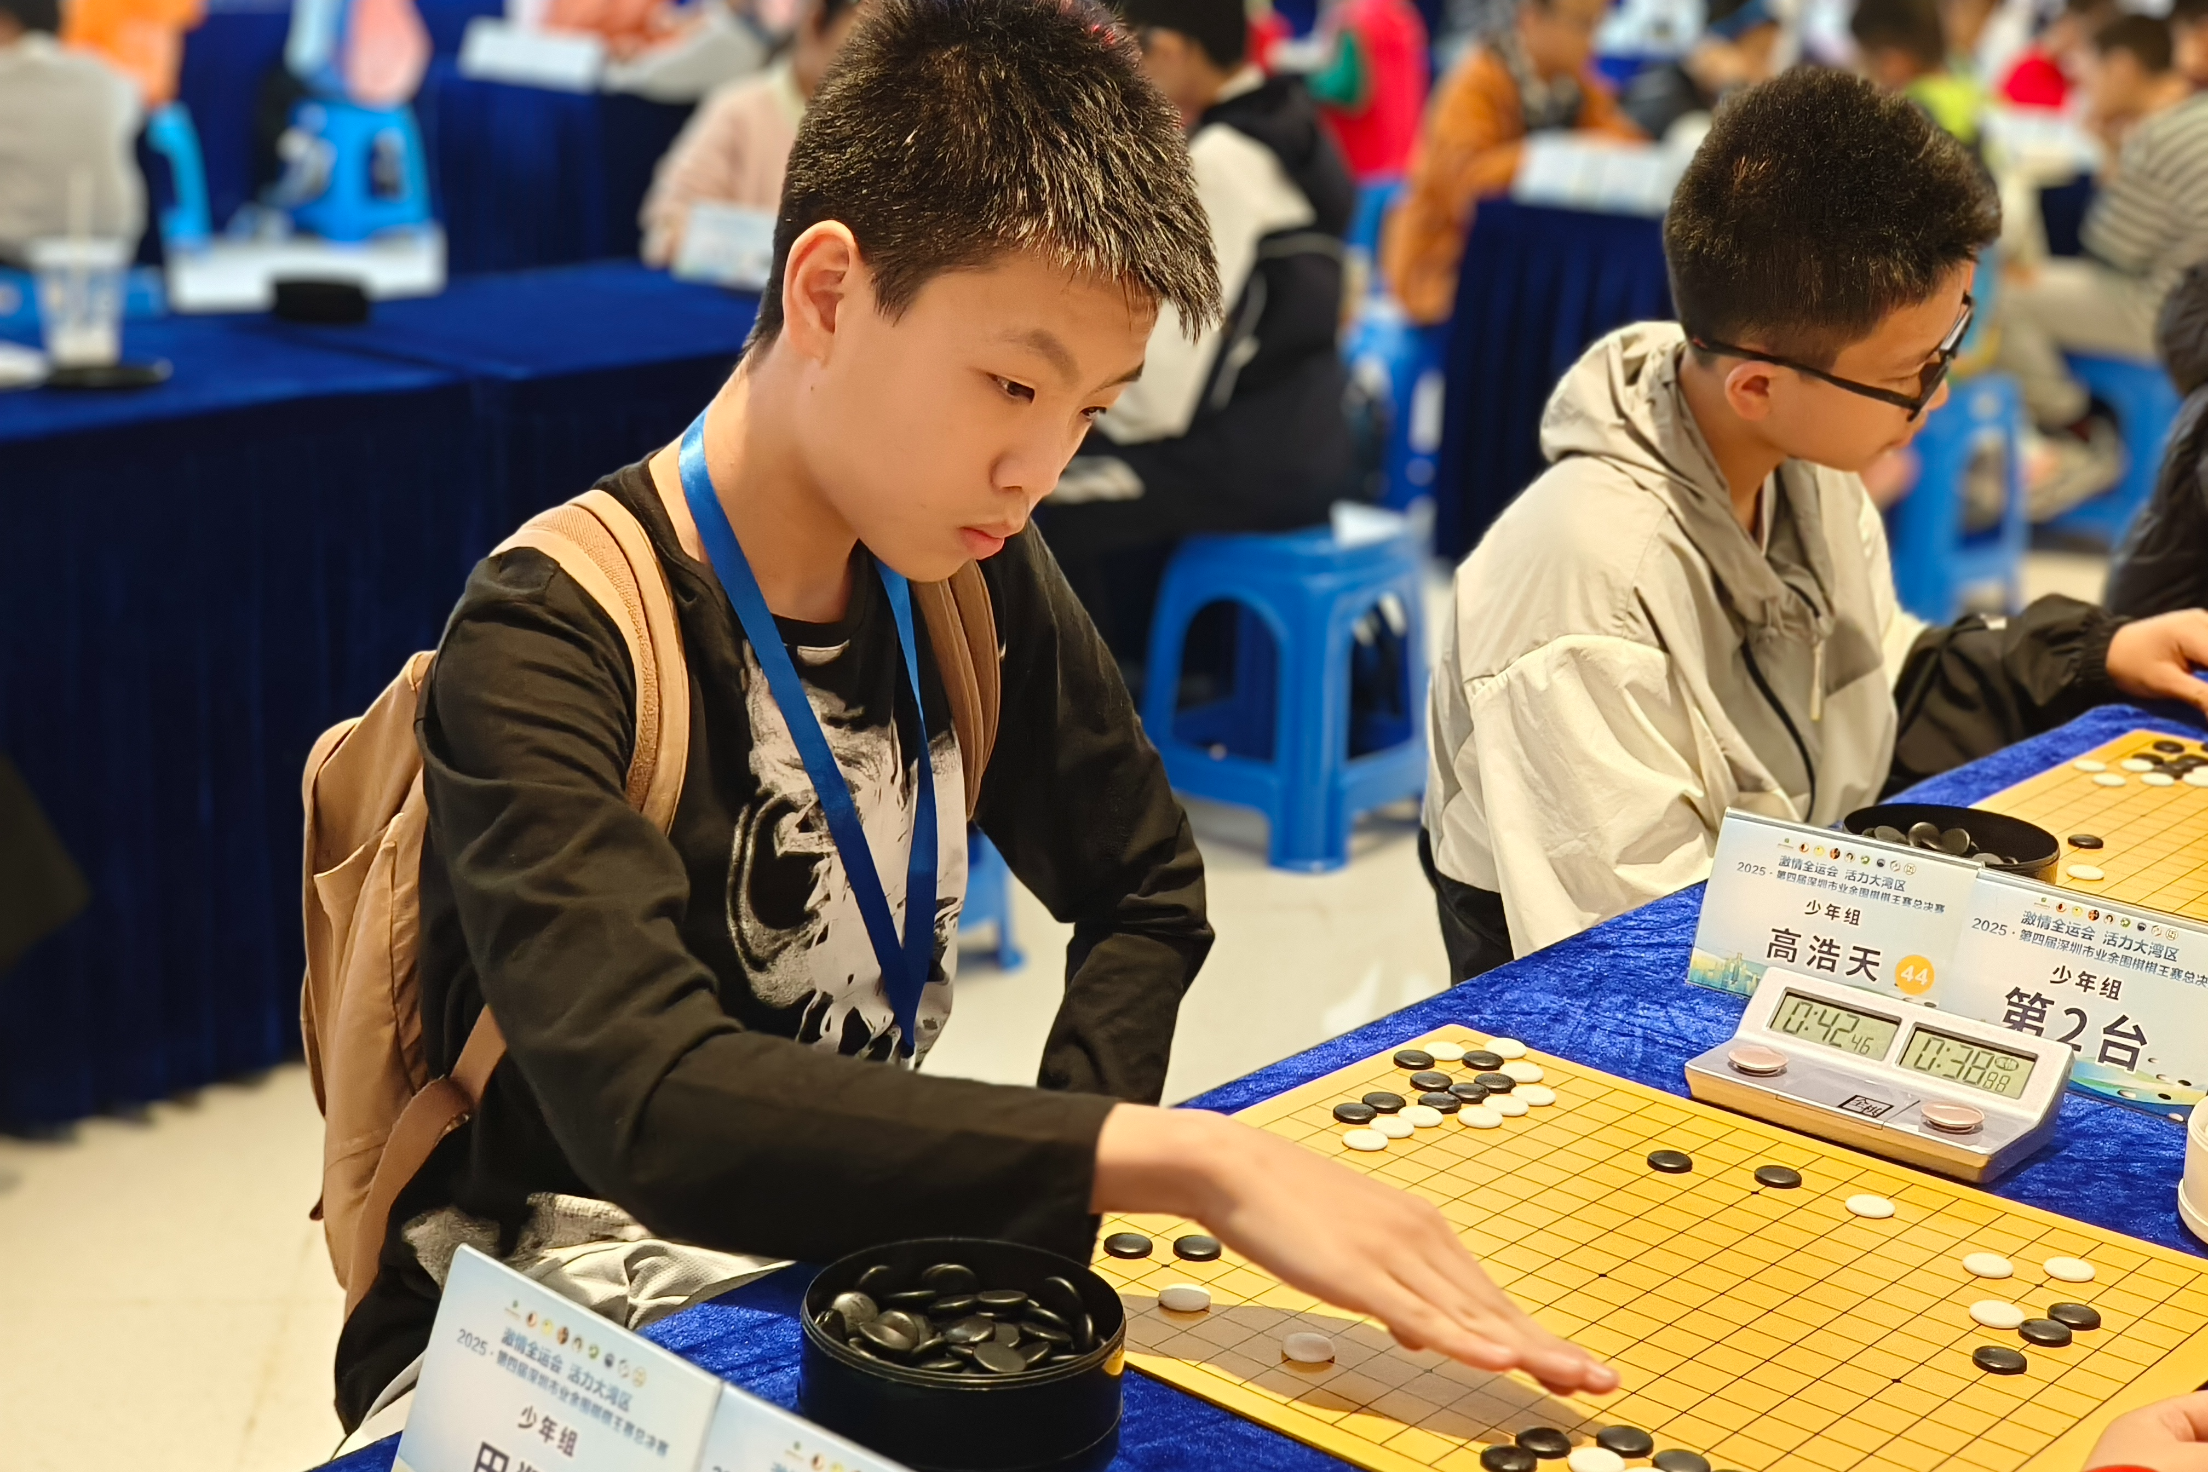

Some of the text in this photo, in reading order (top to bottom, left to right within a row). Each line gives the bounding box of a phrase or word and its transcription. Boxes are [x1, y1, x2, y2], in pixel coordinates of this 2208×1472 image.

[1778, 855, 1907, 892] 激情全运会 活力大湾区
[1804, 899, 1861, 926] 少年组
[1766, 928, 1881, 982] 高浩天
[2020, 910, 2180, 962] 激情全运会 活力大湾区
[1900, 964, 1928, 986] 44
[2050, 965, 2123, 1001] 少年组
[2002, 986, 2148, 1072] 第2台
[517, 1405, 578, 1458] 少年组
